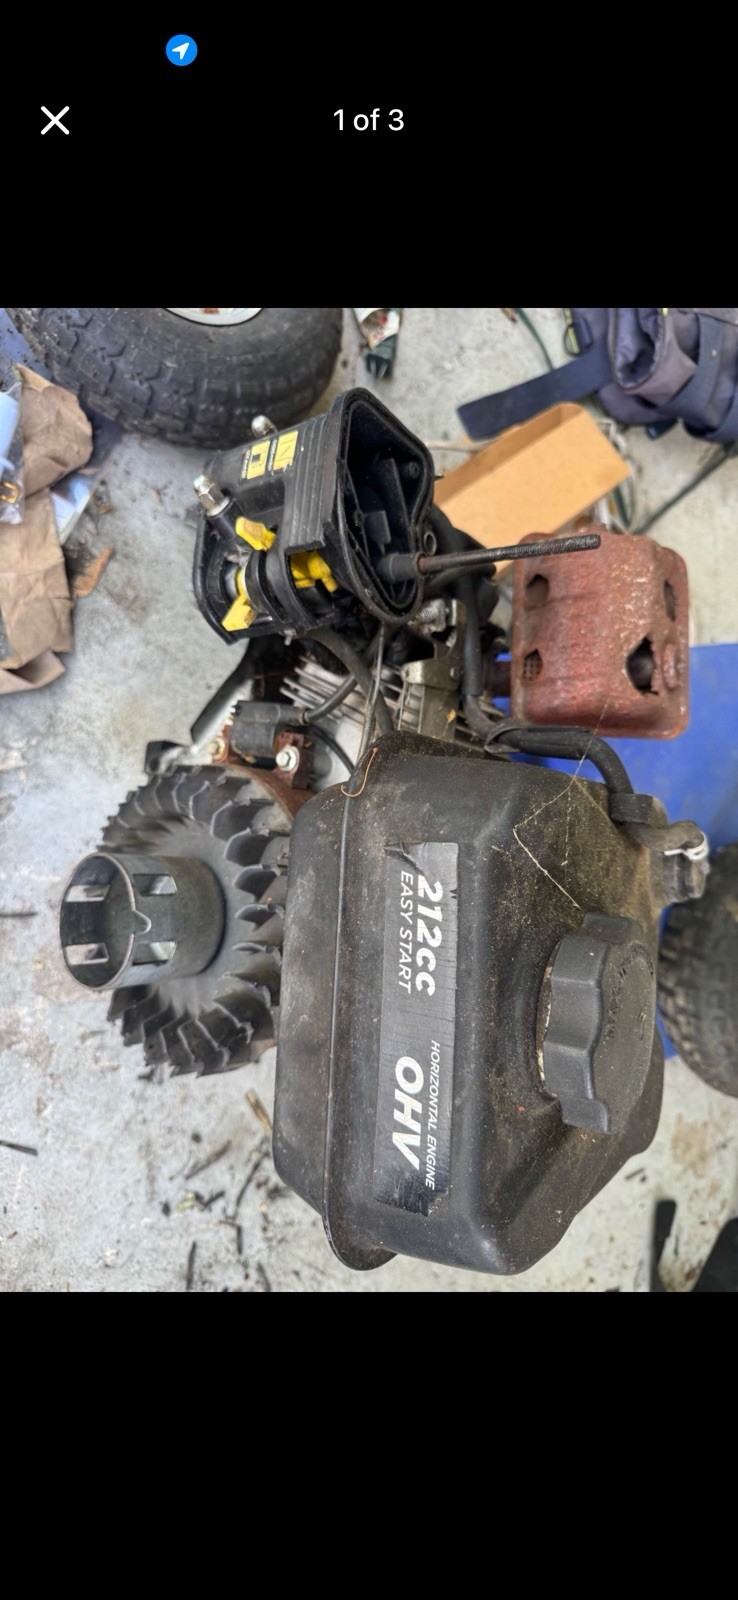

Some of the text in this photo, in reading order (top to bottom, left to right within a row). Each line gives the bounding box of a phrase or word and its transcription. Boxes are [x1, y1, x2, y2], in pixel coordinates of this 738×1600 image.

[398, 871, 414, 994] EASY START
[415, 875, 443, 996] 212cc
[392, 1056, 424, 1170] OHV
[424, 1040, 441, 1190] HORIZONTAL ENGINE
